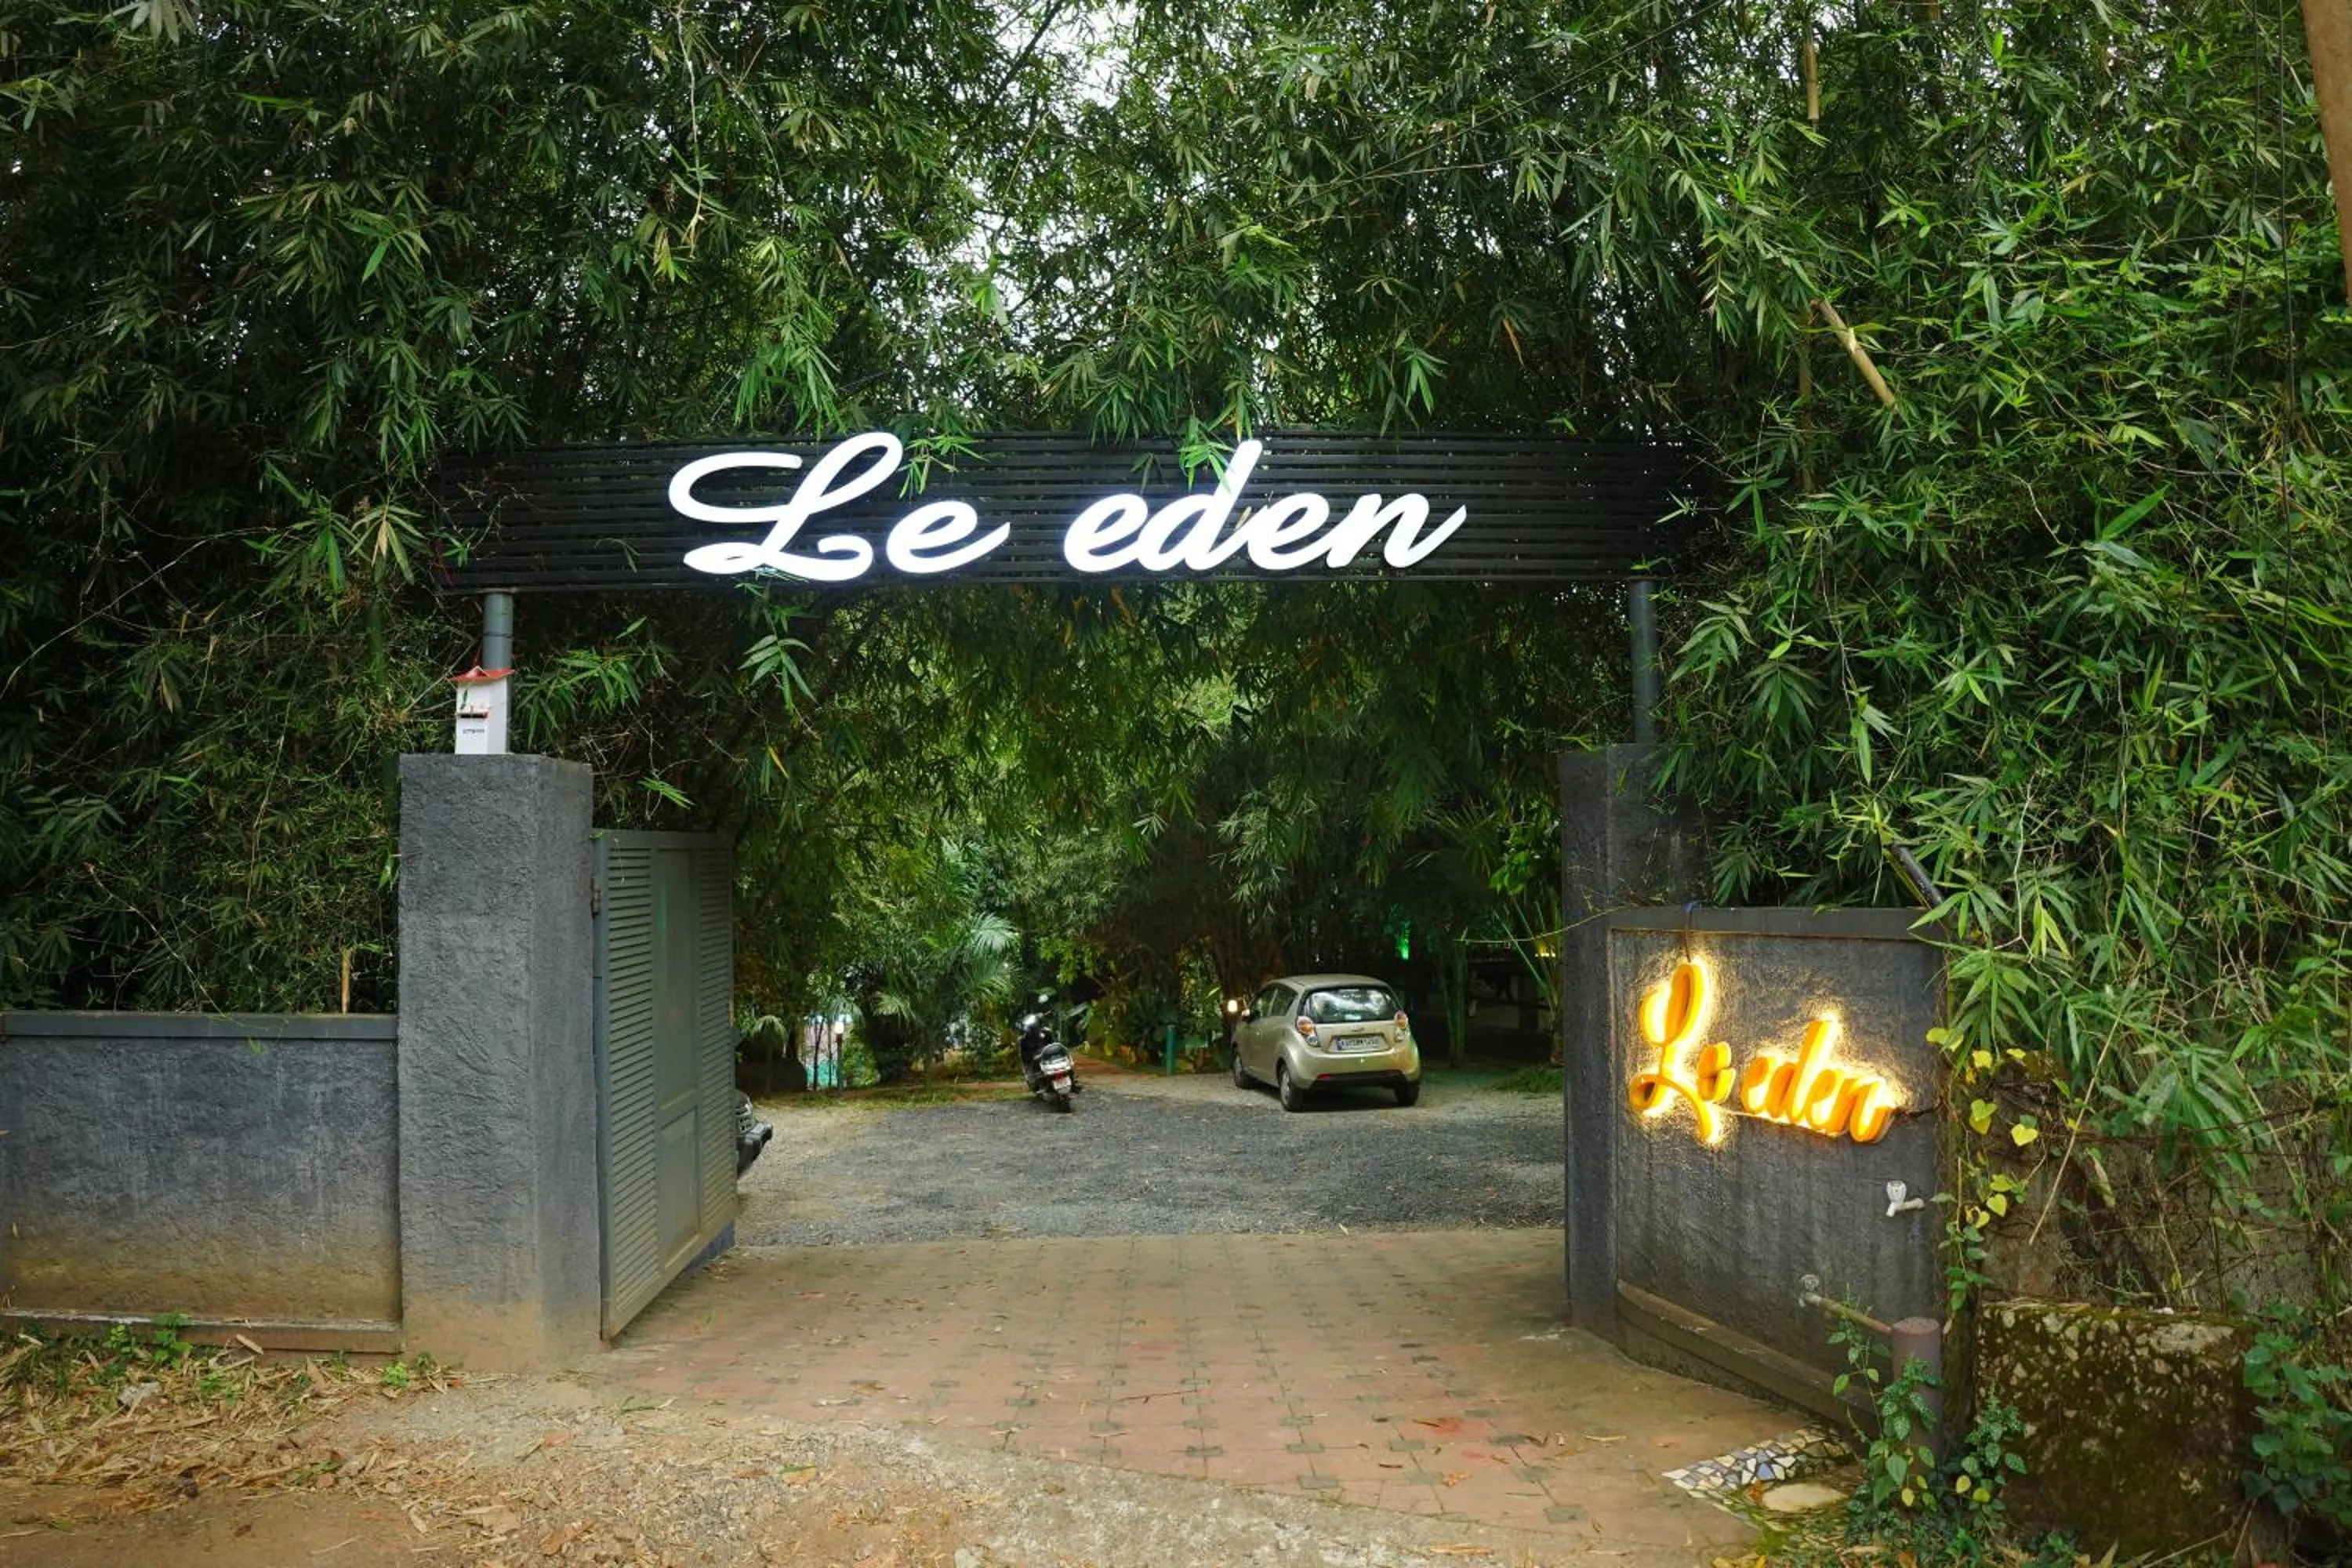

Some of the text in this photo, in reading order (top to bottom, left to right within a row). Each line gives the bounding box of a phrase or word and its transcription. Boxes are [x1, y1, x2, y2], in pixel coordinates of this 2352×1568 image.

[668, 431, 1467, 583] Le eden
[1628, 961, 1896, 1144] Le eden
